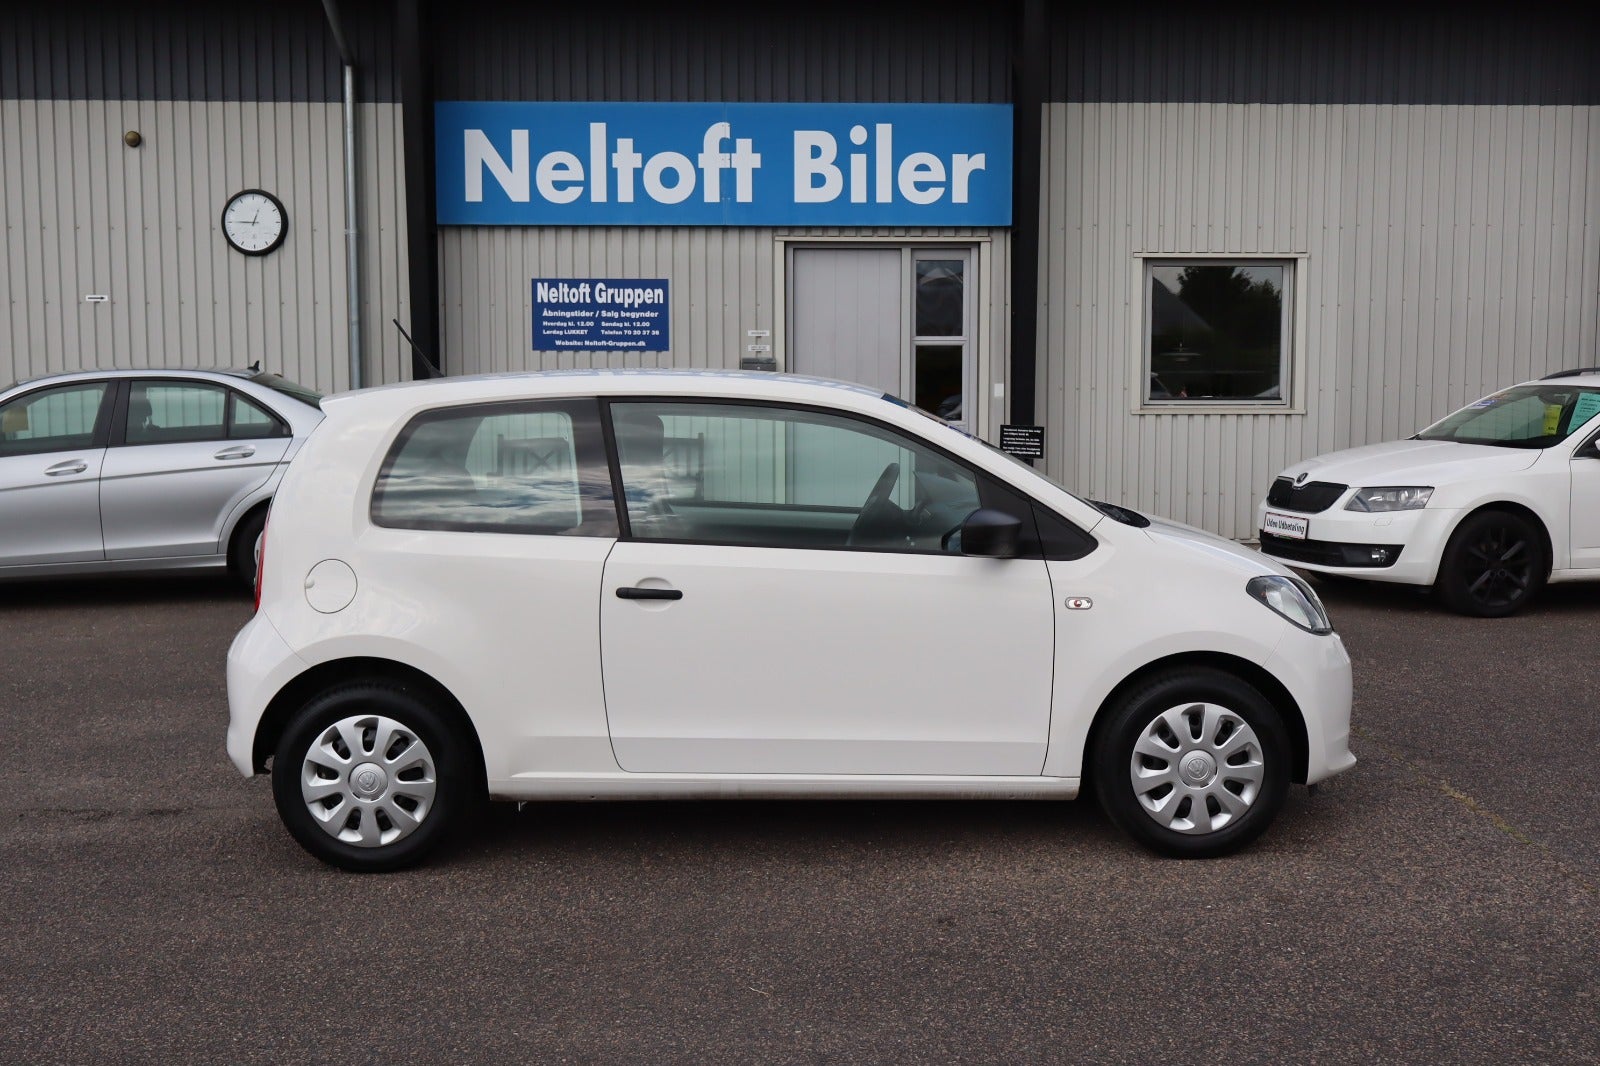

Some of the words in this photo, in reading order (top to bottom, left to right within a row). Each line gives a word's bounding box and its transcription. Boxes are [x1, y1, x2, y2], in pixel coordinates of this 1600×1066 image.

[463, 121, 762, 205] Neltoft
[793, 123, 986, 205] Biler
[537, 282, 591, 303] Neltoft
[594, 282, 664, 308] Gruppen
[543, 307, 594, 318] Åbningstider
[601, 310, 619, 319] Salg
[620, 310, 659, 319] begynder
[1279, 520, 1304, 534] Udbetaling
